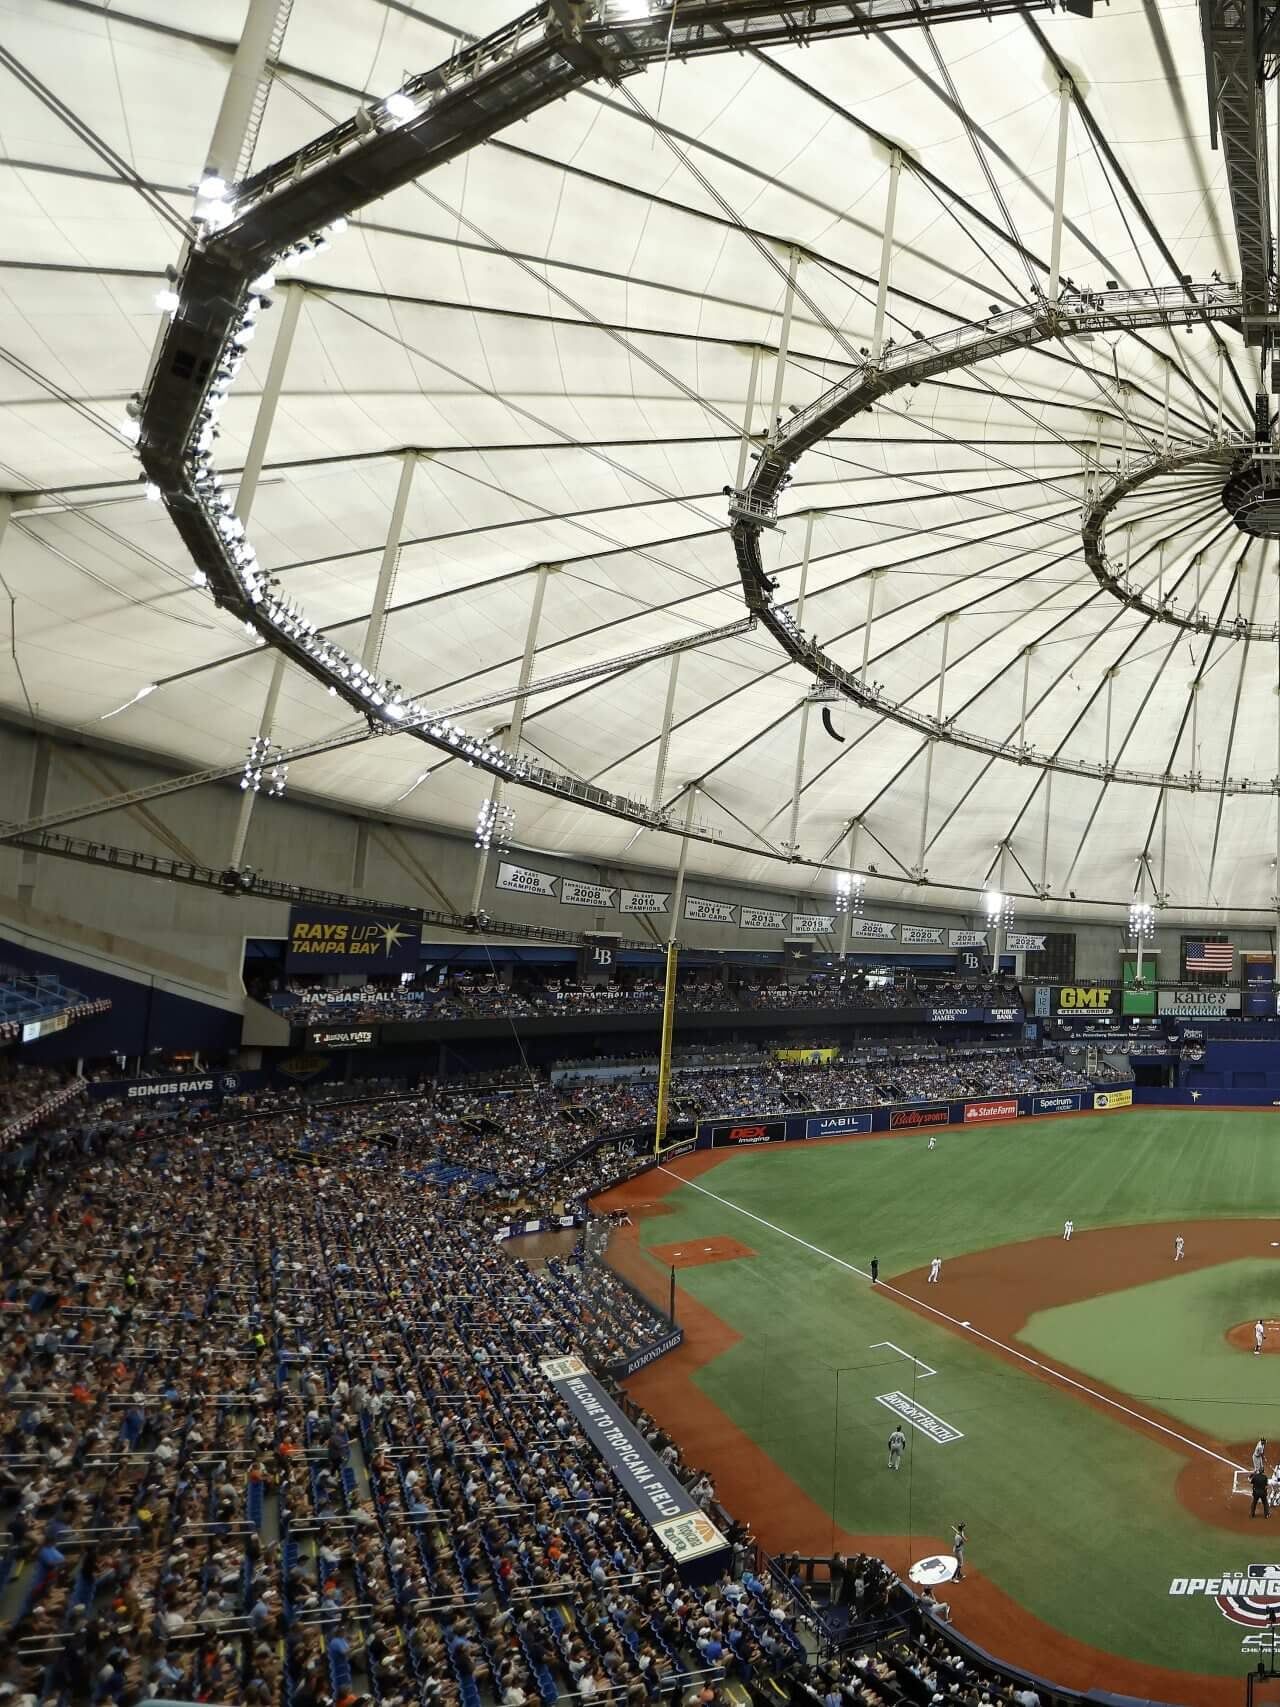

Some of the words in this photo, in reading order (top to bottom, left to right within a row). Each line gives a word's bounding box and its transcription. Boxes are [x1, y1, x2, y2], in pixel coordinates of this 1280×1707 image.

[502, 880, 546, 894] CHAMPIONS
[512, 874, 539, 886] 2008
[565, 895, 607, 906] CHAMPIONS
[574, 888, 601, 899] 2008
[631, 898, 655, 906] 2010
[698, 906, 721, 915] 2011
[708, 912, 727, 921] CARD
[751, 914, 774, 922] 2013
[293, 923, 349, 940] RAYS
[352, 926, 378, 940] UP
[291, 941, 346, 953] TAMPA
[349, 942, 380, 955] BAY
[1061, 988, 1111, 1008] GMF
[128, 1083, 178, 1097] SOMOS
[179, 1080, 214, 1092] RAYS
[1040, 1098, 1072, 1109] Spectrum
[820, 1117, 859, 1128] JABIL
[729, 1126, 768, 1140] DEX
[628, 1347, 661, 1374] RAYMOND
[661, 1334, 681, 1353] JAMES
[566, 1377, 602, 1416] WELCOME
[594, 1414, 614, 1429] TO
[883, 1393, 926, 1425] BAYFRONT
[918, 1416, 954, 1440] HEALTH
[603, 1426, 656, 1484] TROPICANA
[644, 1481, 681, 1517] FIELD
